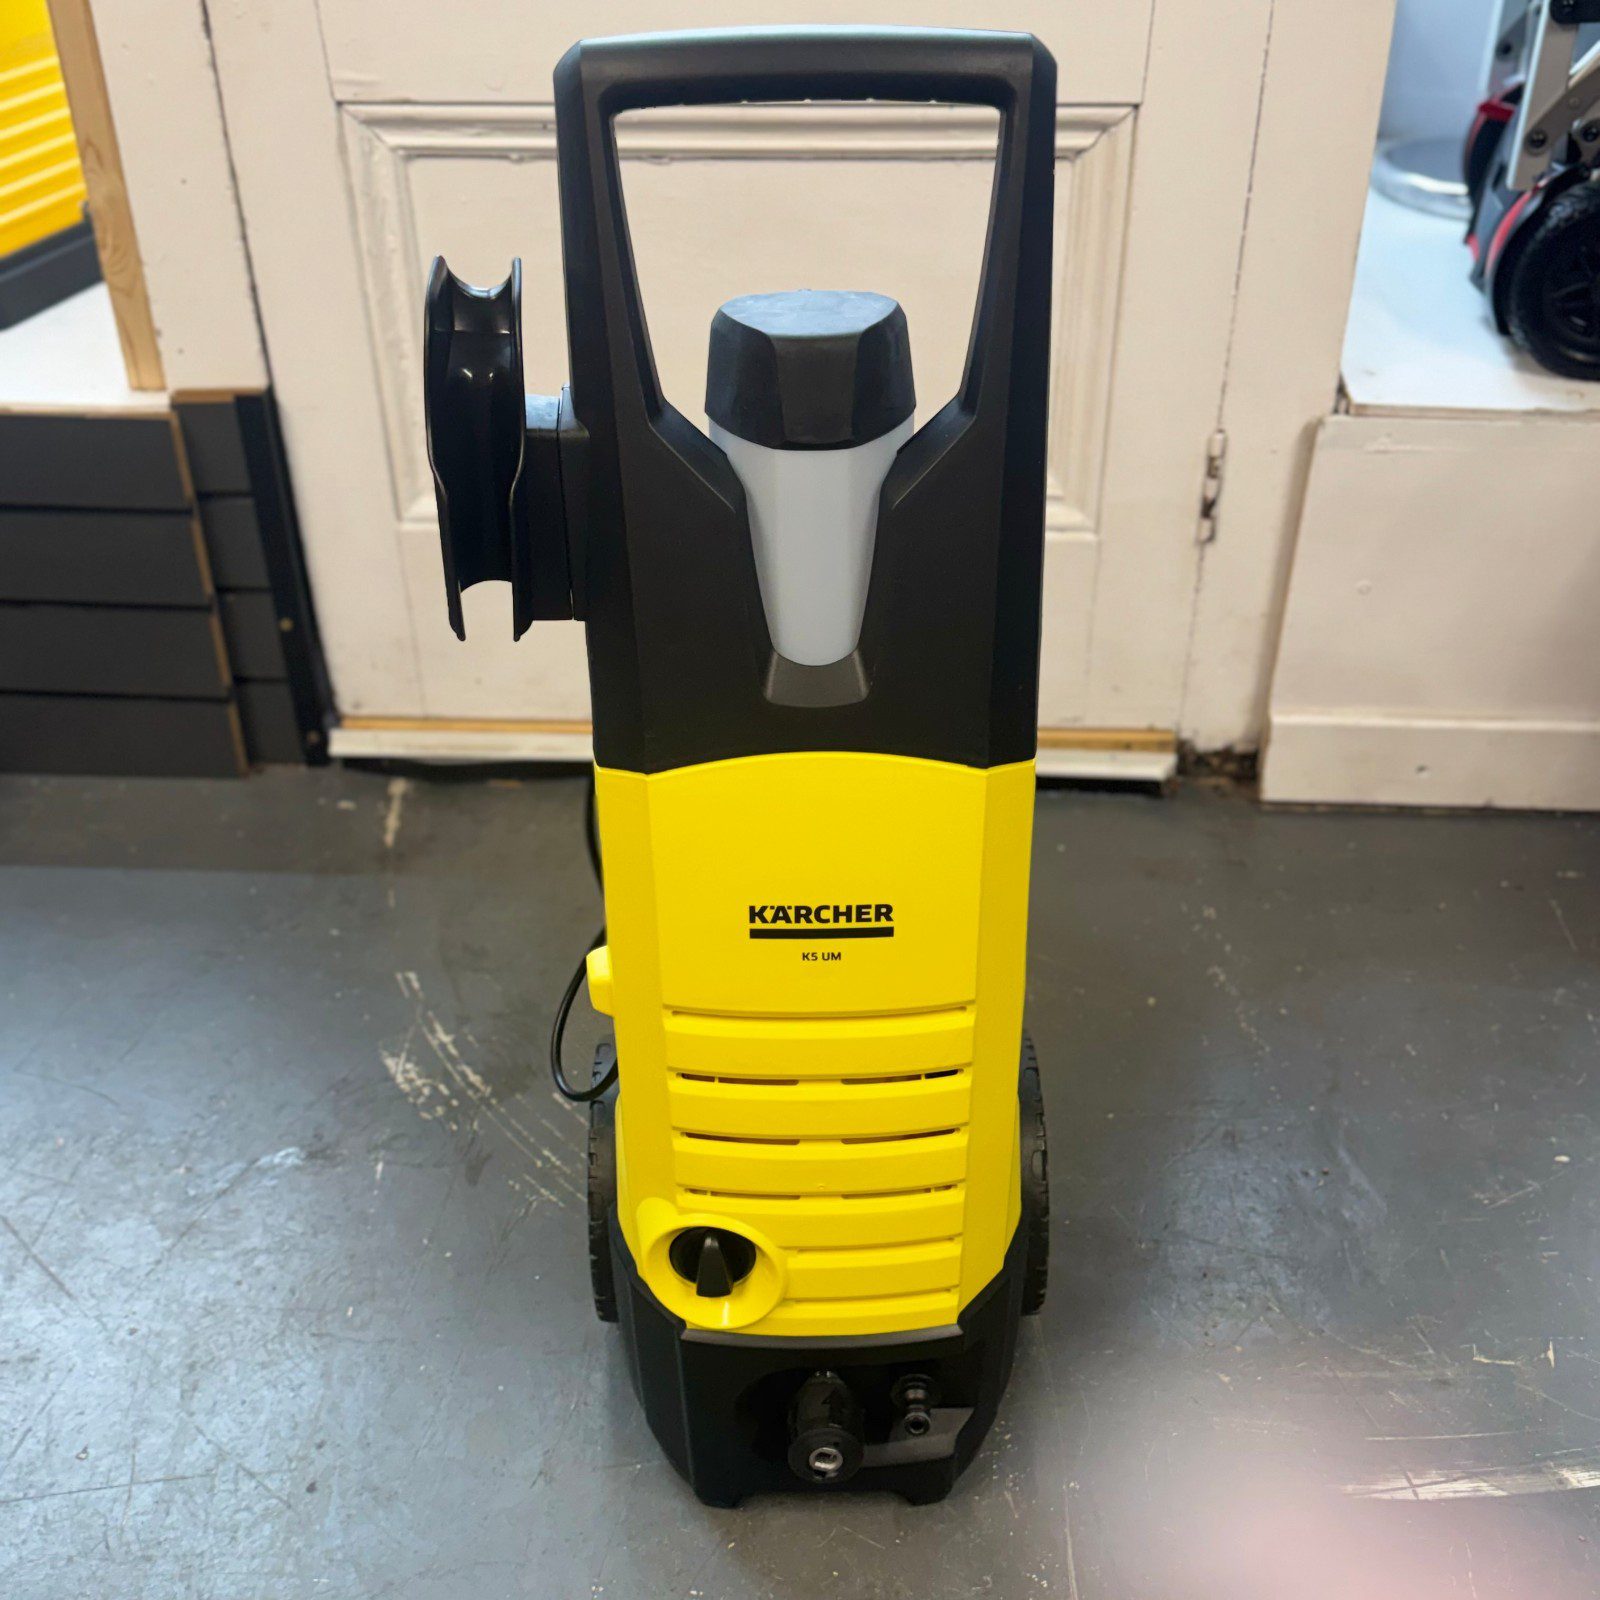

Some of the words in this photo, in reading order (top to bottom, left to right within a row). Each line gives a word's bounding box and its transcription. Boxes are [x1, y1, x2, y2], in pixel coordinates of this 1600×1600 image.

[749, 904, 894, 924] KÄRCHER
[802, 952, 818, 961] K5
[822, 952, 842, 961] UM
